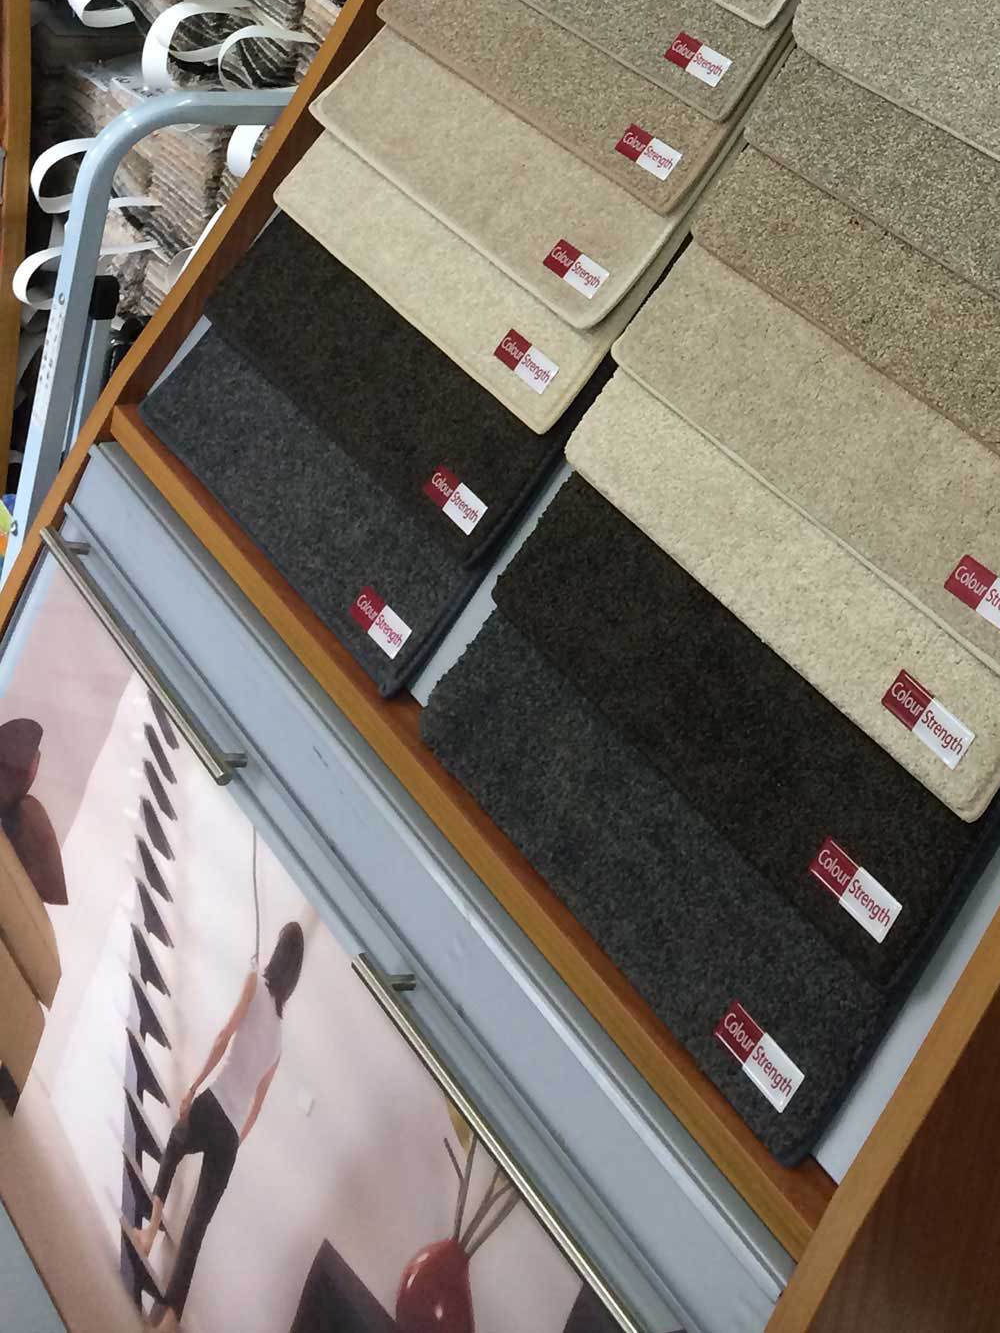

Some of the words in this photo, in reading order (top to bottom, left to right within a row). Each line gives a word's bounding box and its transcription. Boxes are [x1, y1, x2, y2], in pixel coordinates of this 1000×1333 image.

[672, 40, 696, 60] Colour
[693, 53, 723, 76] Strength
[623, 132, 646, 152] Colour
[644, 145, 673, 169] Strength
[551, 246, 574, 267] Colour
[571, 261, 600, 288] Strength
[501, 337, 524, 360] Colour
[521, 354, 551, 384] Strength
[431, 472, 453, 497] Colour
[450, 491, 479, 523] Strength
[954, 565, 988, 597] Colour
[356, 594, 378, 619] Colour
[375, 614, 403, 647] Strength
[890, 682, 924, 716] Colour
[920, 709, 964, 756] Strength
[817, 849, 851, 887] Colour
[848, 878, 891, 927] Strength
[723, 1013, 756, 1052] Colour
[752, 1045, 793, 1098] Strength
